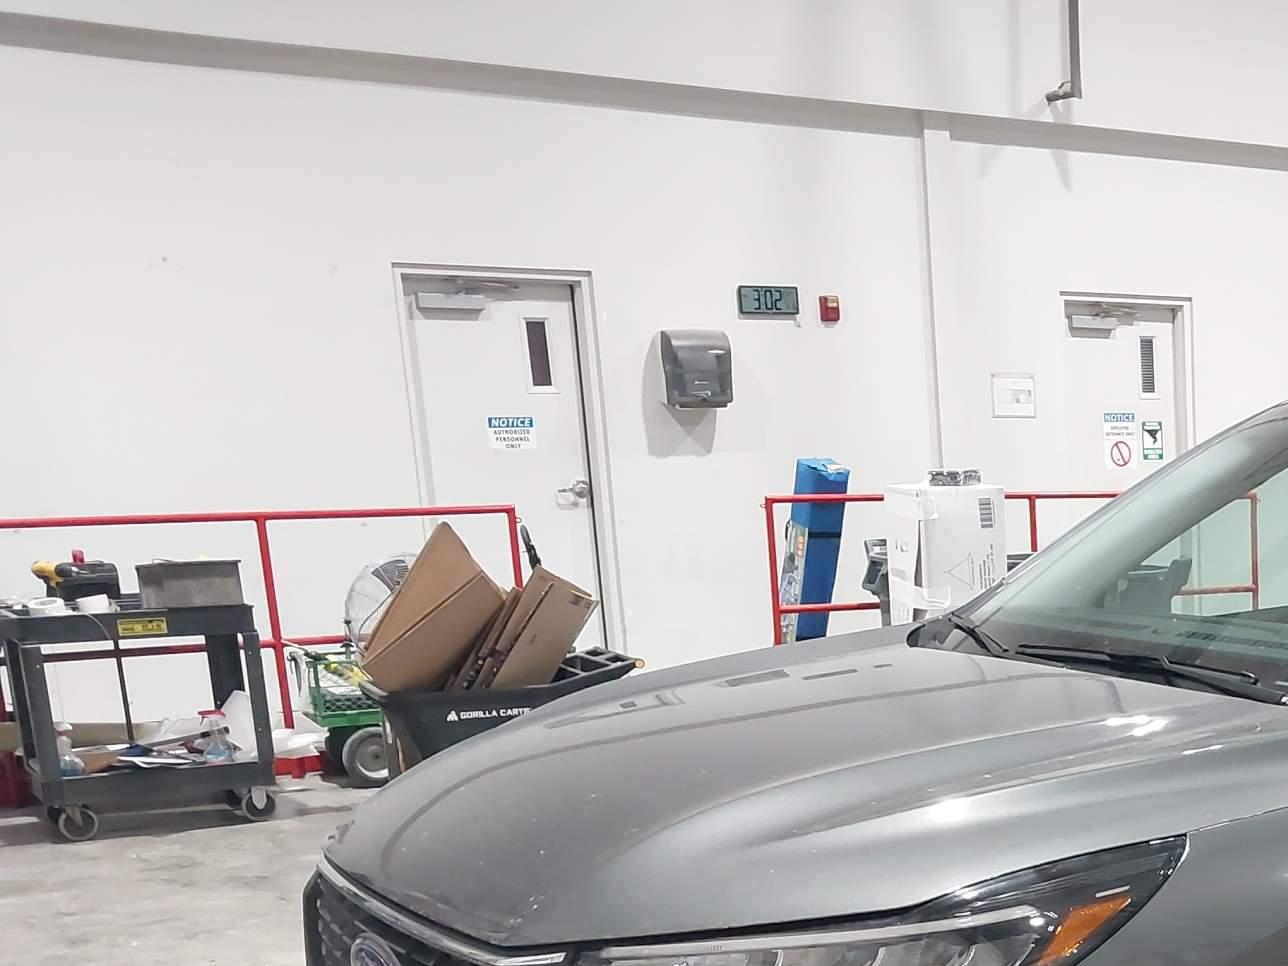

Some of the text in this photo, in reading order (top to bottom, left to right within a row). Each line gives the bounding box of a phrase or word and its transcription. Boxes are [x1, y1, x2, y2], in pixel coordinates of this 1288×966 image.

[752, 289, 783, 311] 3:02
[491, 418, 531, 427] NOTICE
[1105, 414, 1134, 422] NOTICE
[460, 709, 498, 719] GORILLA
